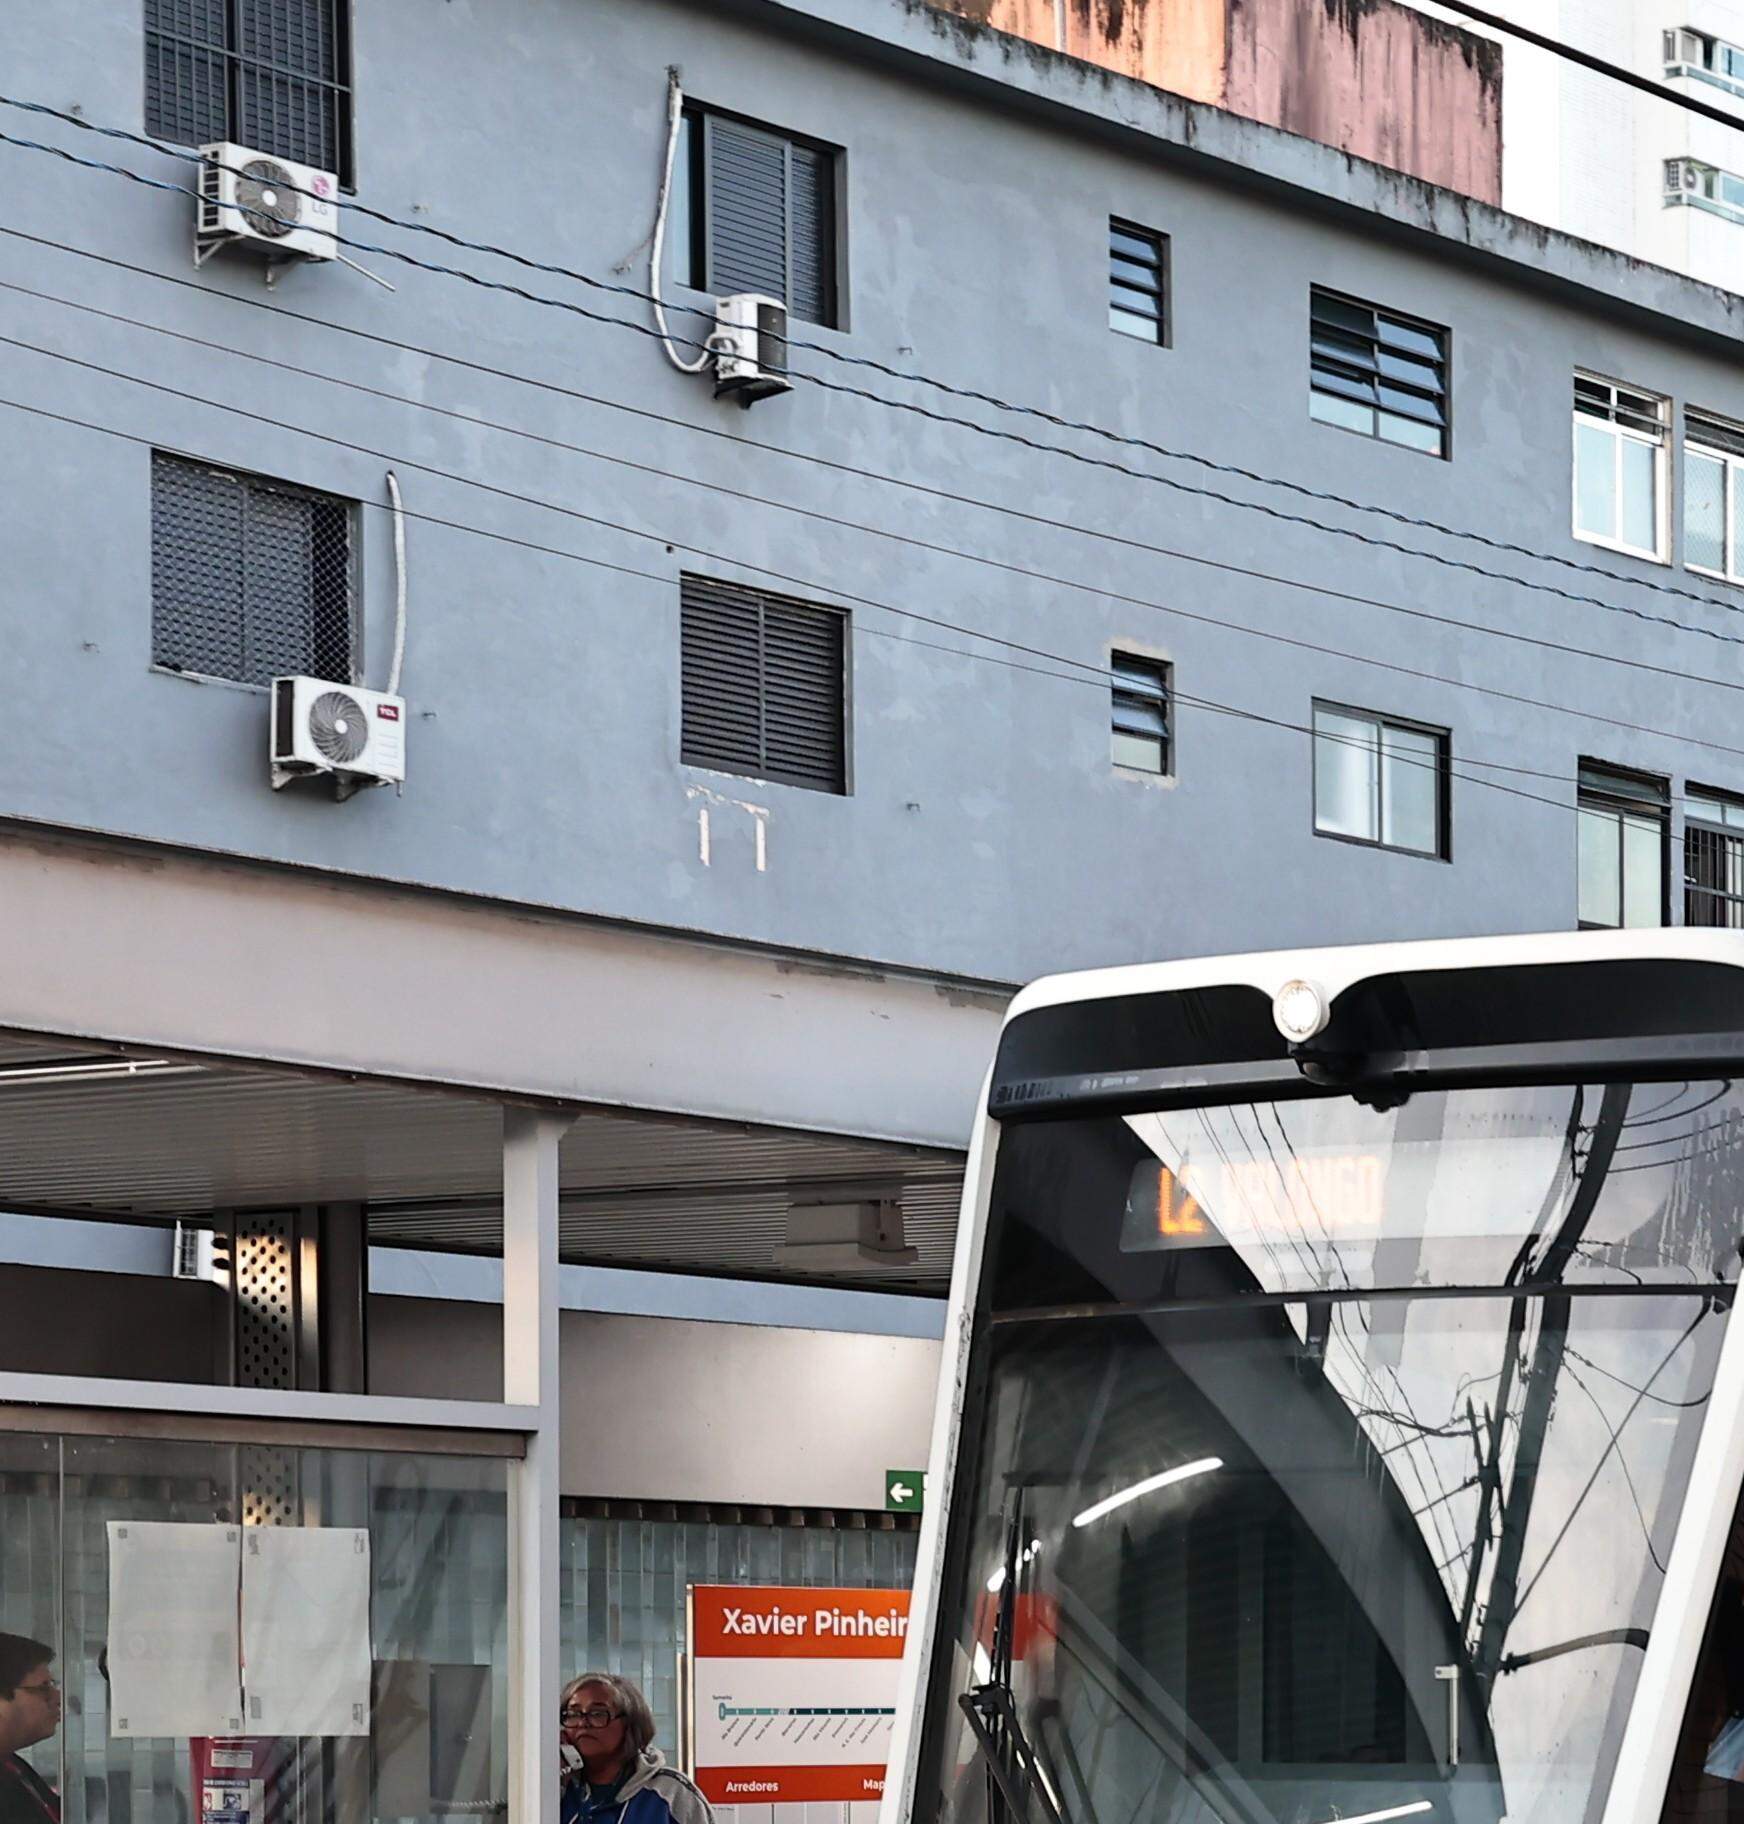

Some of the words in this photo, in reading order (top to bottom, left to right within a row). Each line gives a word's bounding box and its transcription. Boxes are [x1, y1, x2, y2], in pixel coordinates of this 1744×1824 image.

[379, 707, 398, 718] TCL
[1159, 1164, 1206, 1235] L2
[722, 1606, 808, 1636] Xavier
[815, 1608, 909, 1637] Pinheir
[725, 1780, 779, 1793] Arredores
